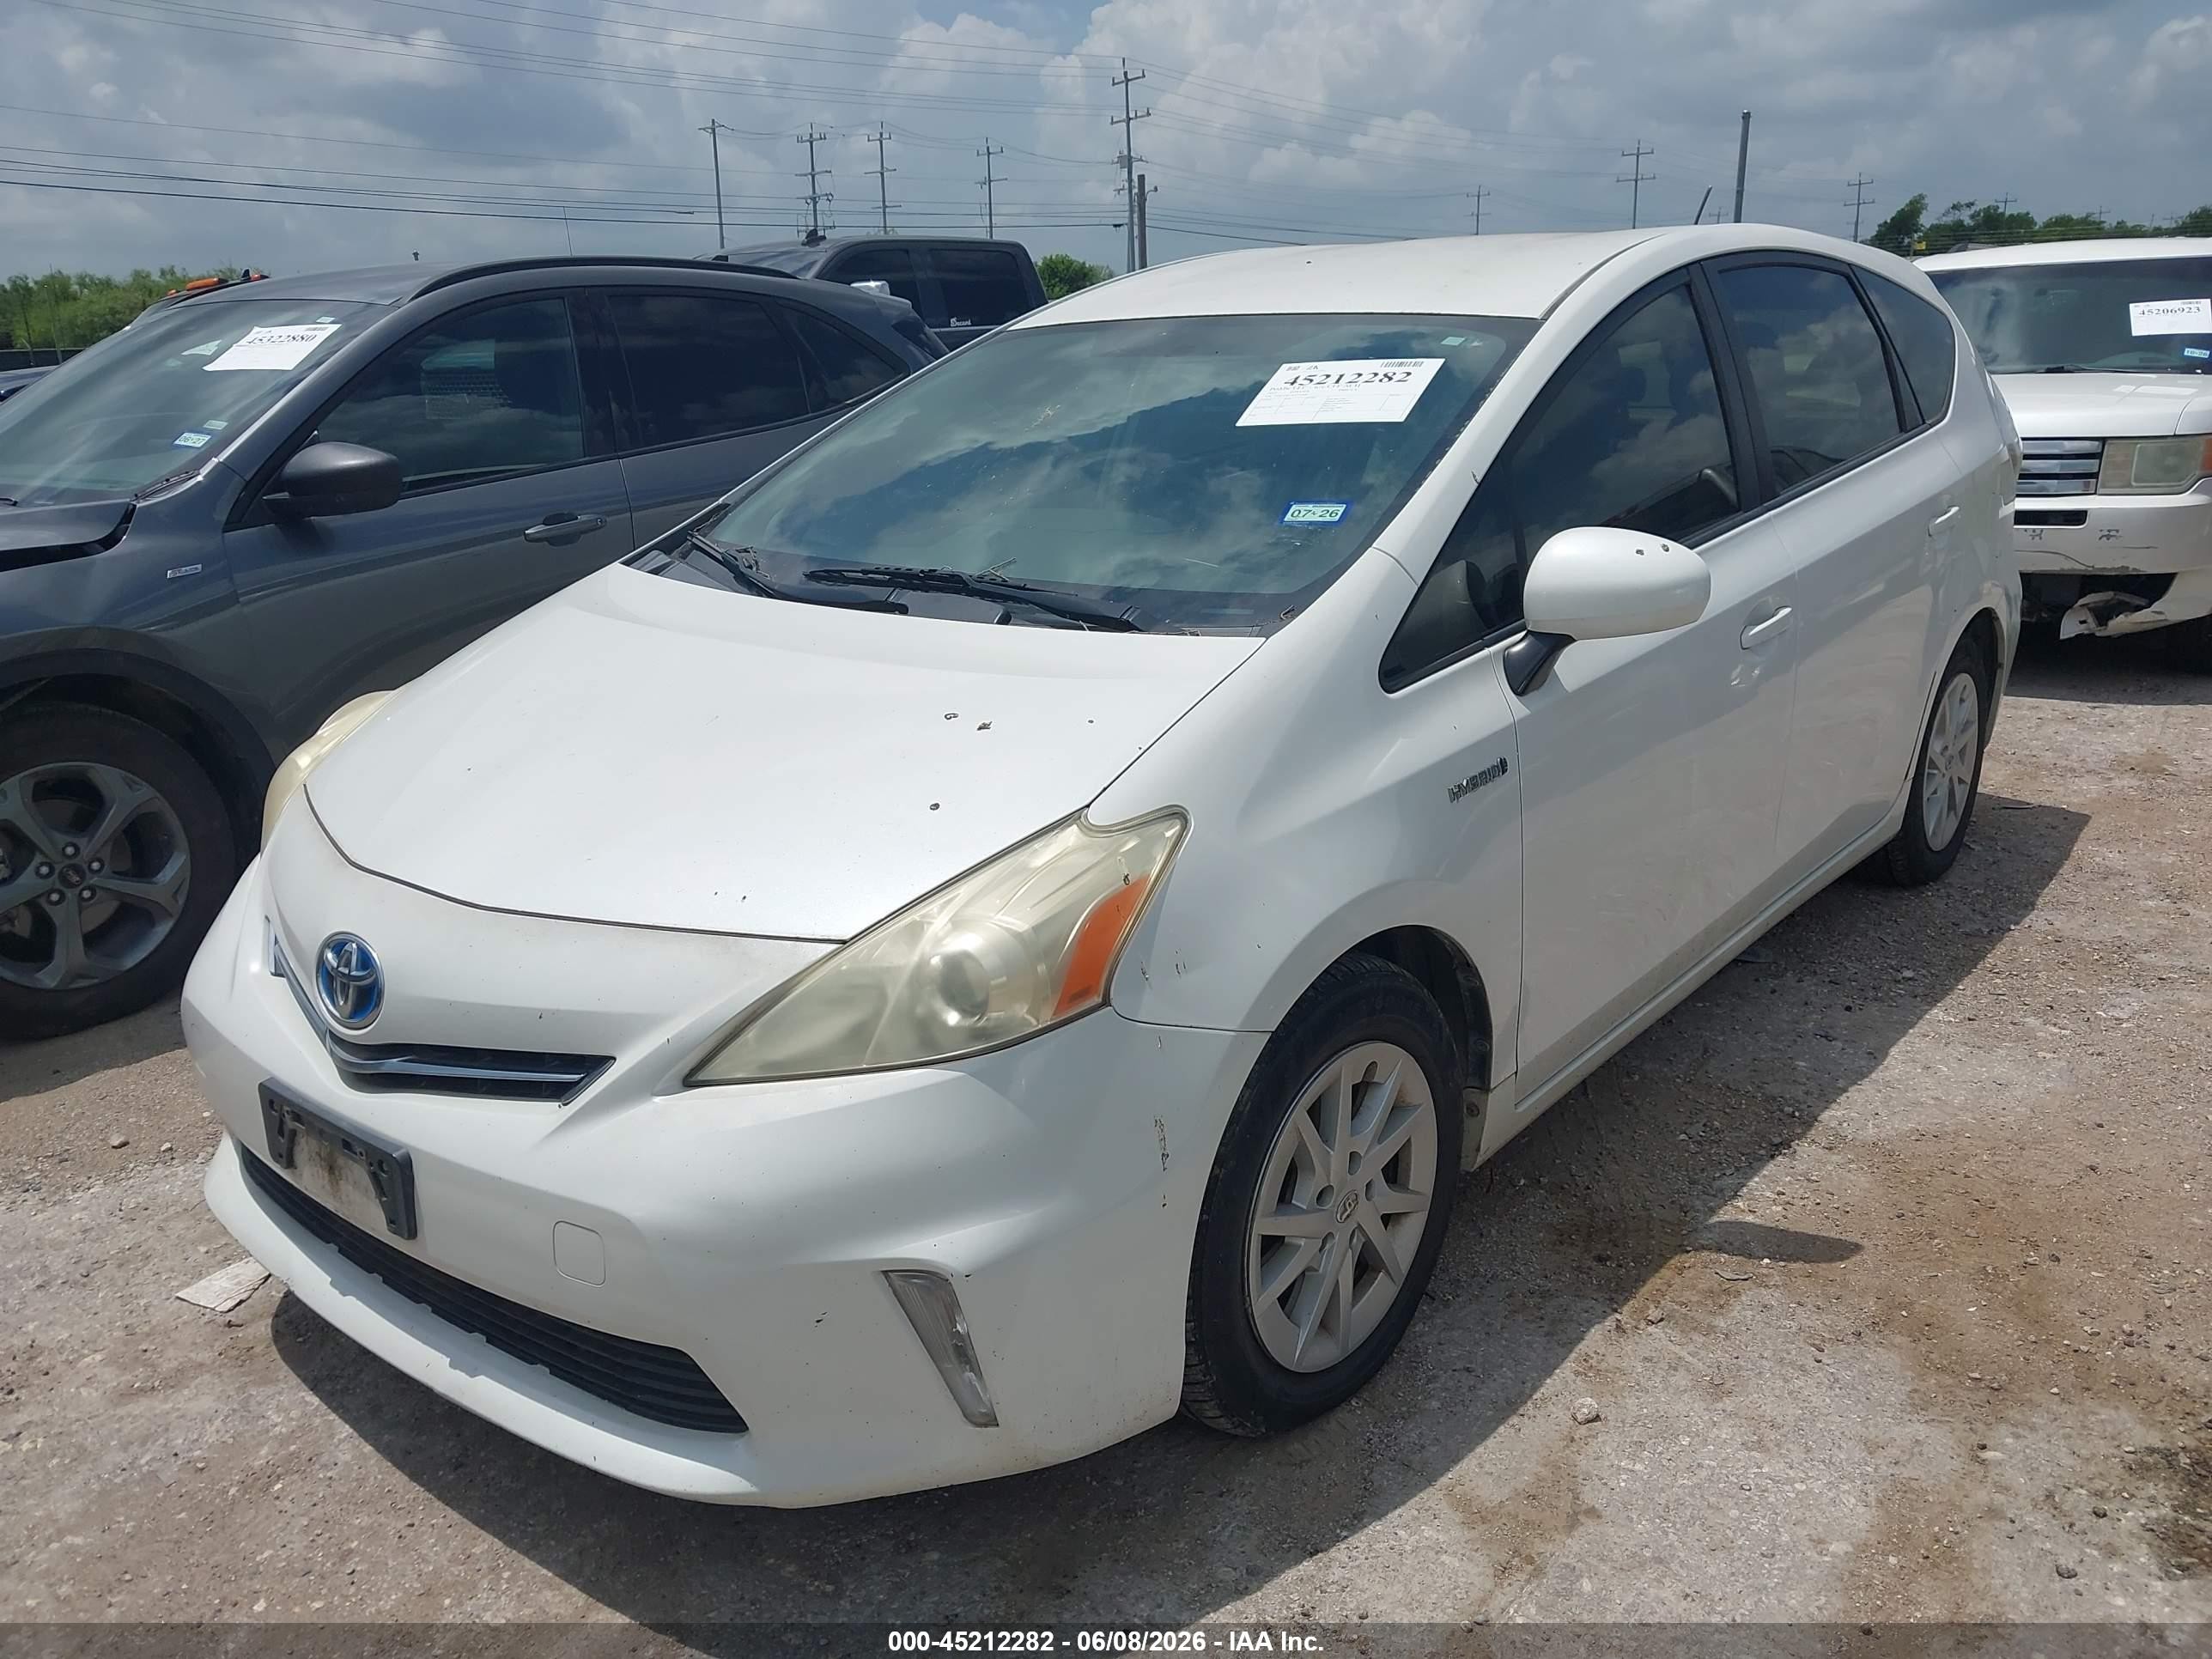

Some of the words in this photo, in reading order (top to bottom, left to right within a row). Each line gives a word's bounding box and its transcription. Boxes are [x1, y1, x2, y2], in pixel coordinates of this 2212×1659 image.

[2138, 306, 2202, 316] 45206923
[246, 333, 318, 344] 45322880
[1284, 370, 1413, 387] 45212282
